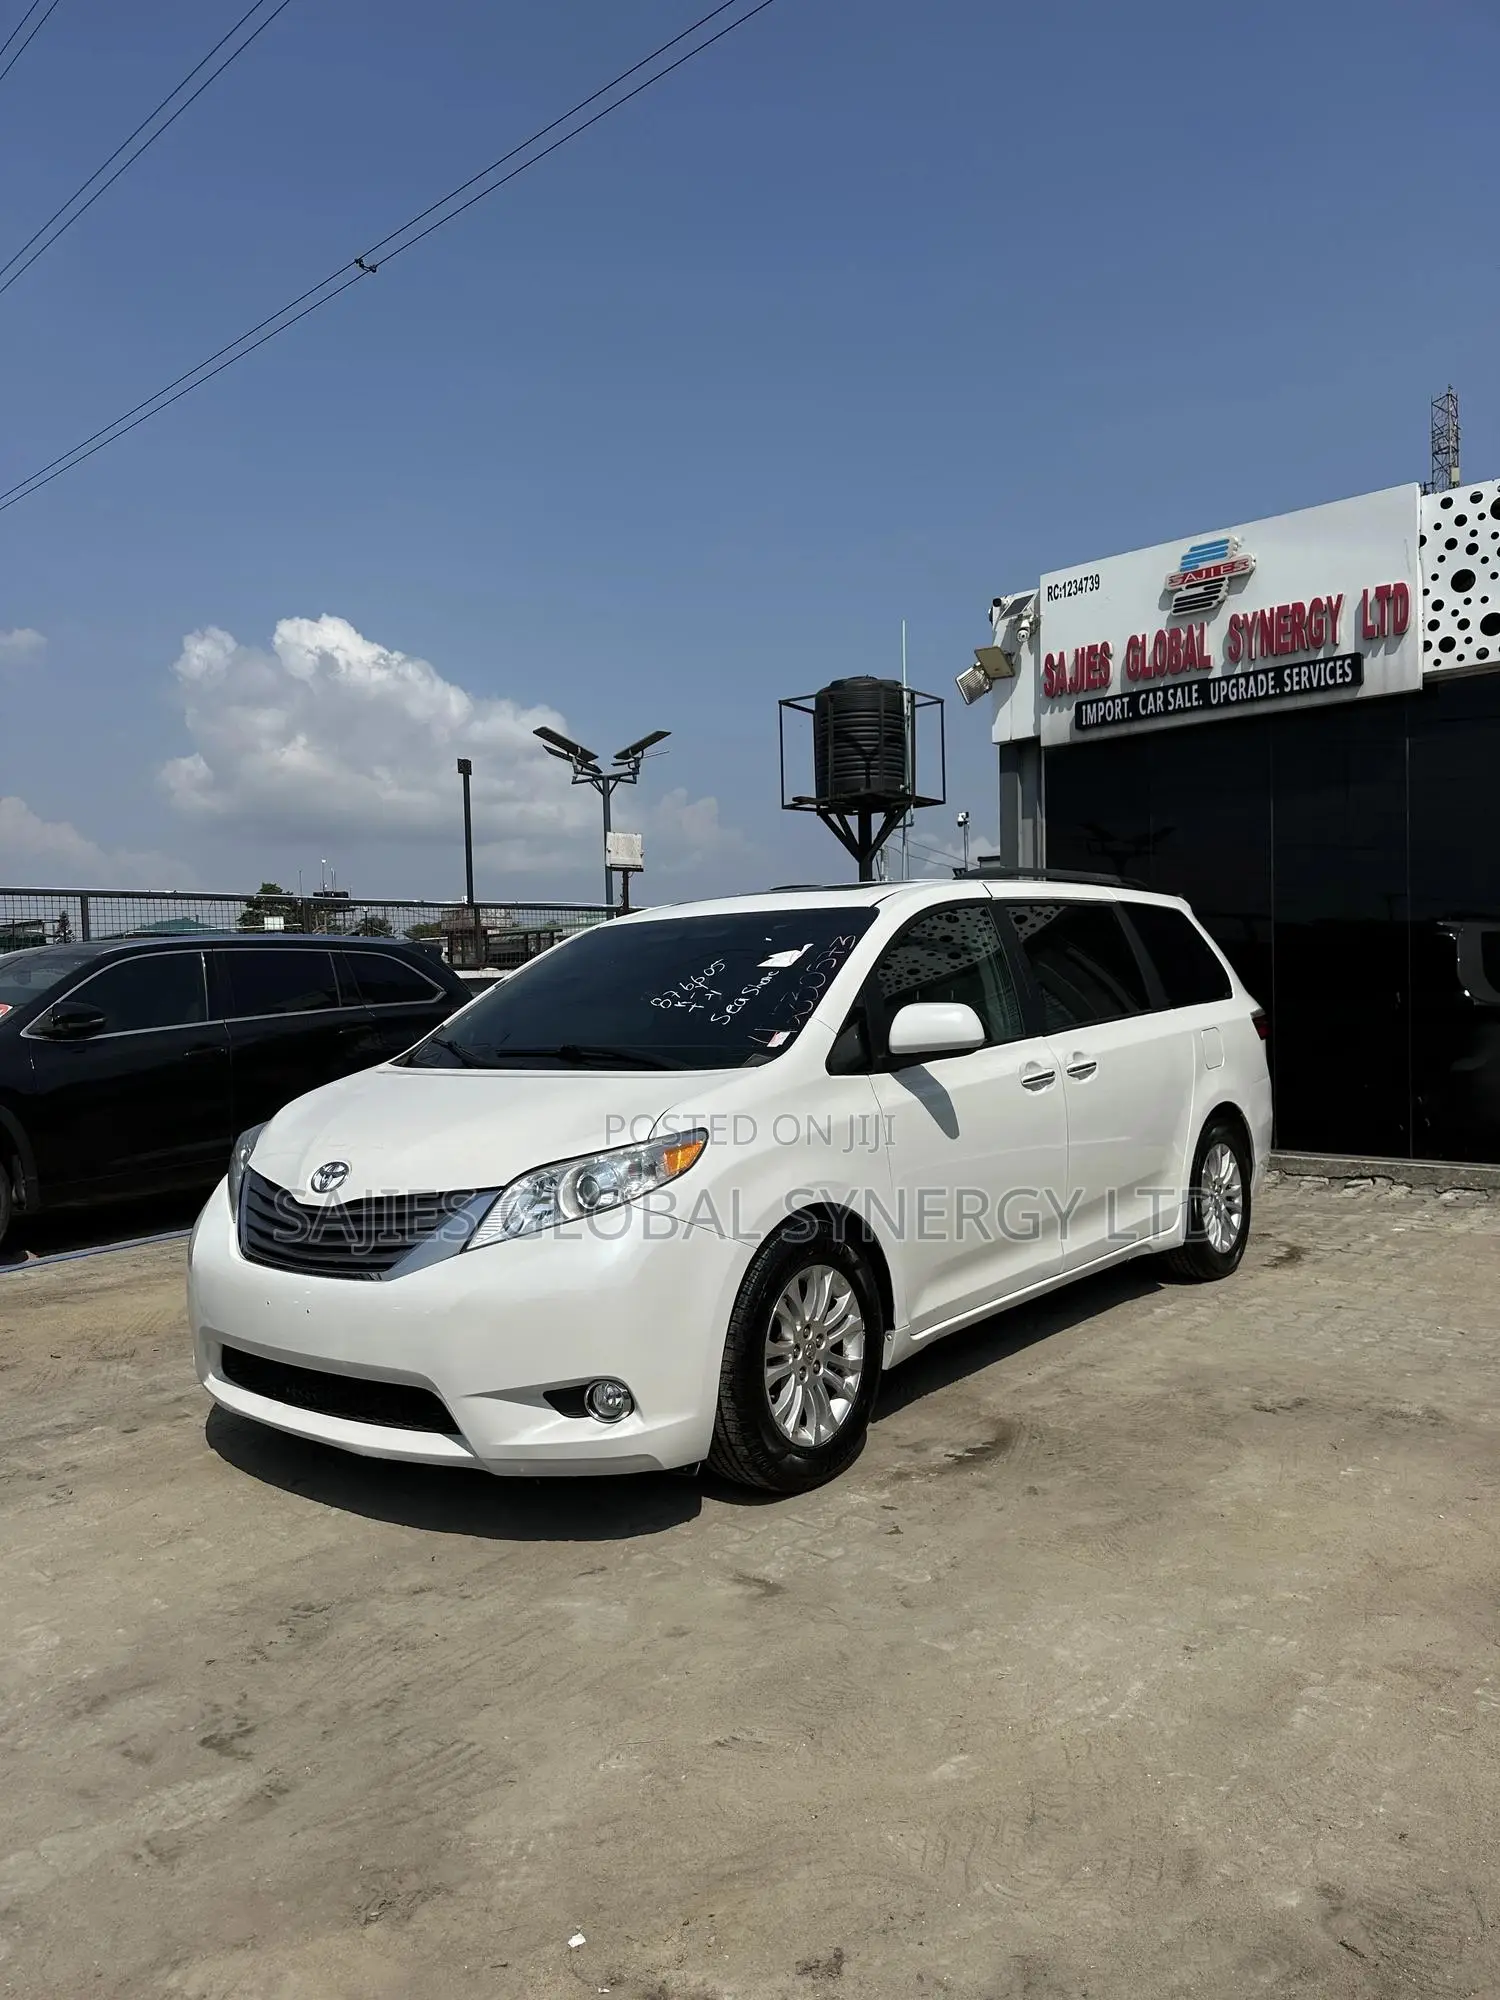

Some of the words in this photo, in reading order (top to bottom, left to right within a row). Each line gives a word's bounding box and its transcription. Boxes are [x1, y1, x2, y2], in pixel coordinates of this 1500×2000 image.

[1047, 573, 1100, 602] RC:1234739
[1168, 558, 1249, 588] SAJIES
[1043, 641, 1113, 698] SAJIES
[1125, 621, 1214, 682] GLOBAL
[1228, 593, 1345, 664] SYNERGY
[1362, 581, 1411, 640] LTD
[1081, 696, 1133, 727] IMPORT.
[1138, 692, 1164, 715] CAR
[1167, 684, 1203, 711] SALE.
[1209, 672, 1280, 705] UPGRADE.
[1283, 658, 1353, 692] SERVICES
